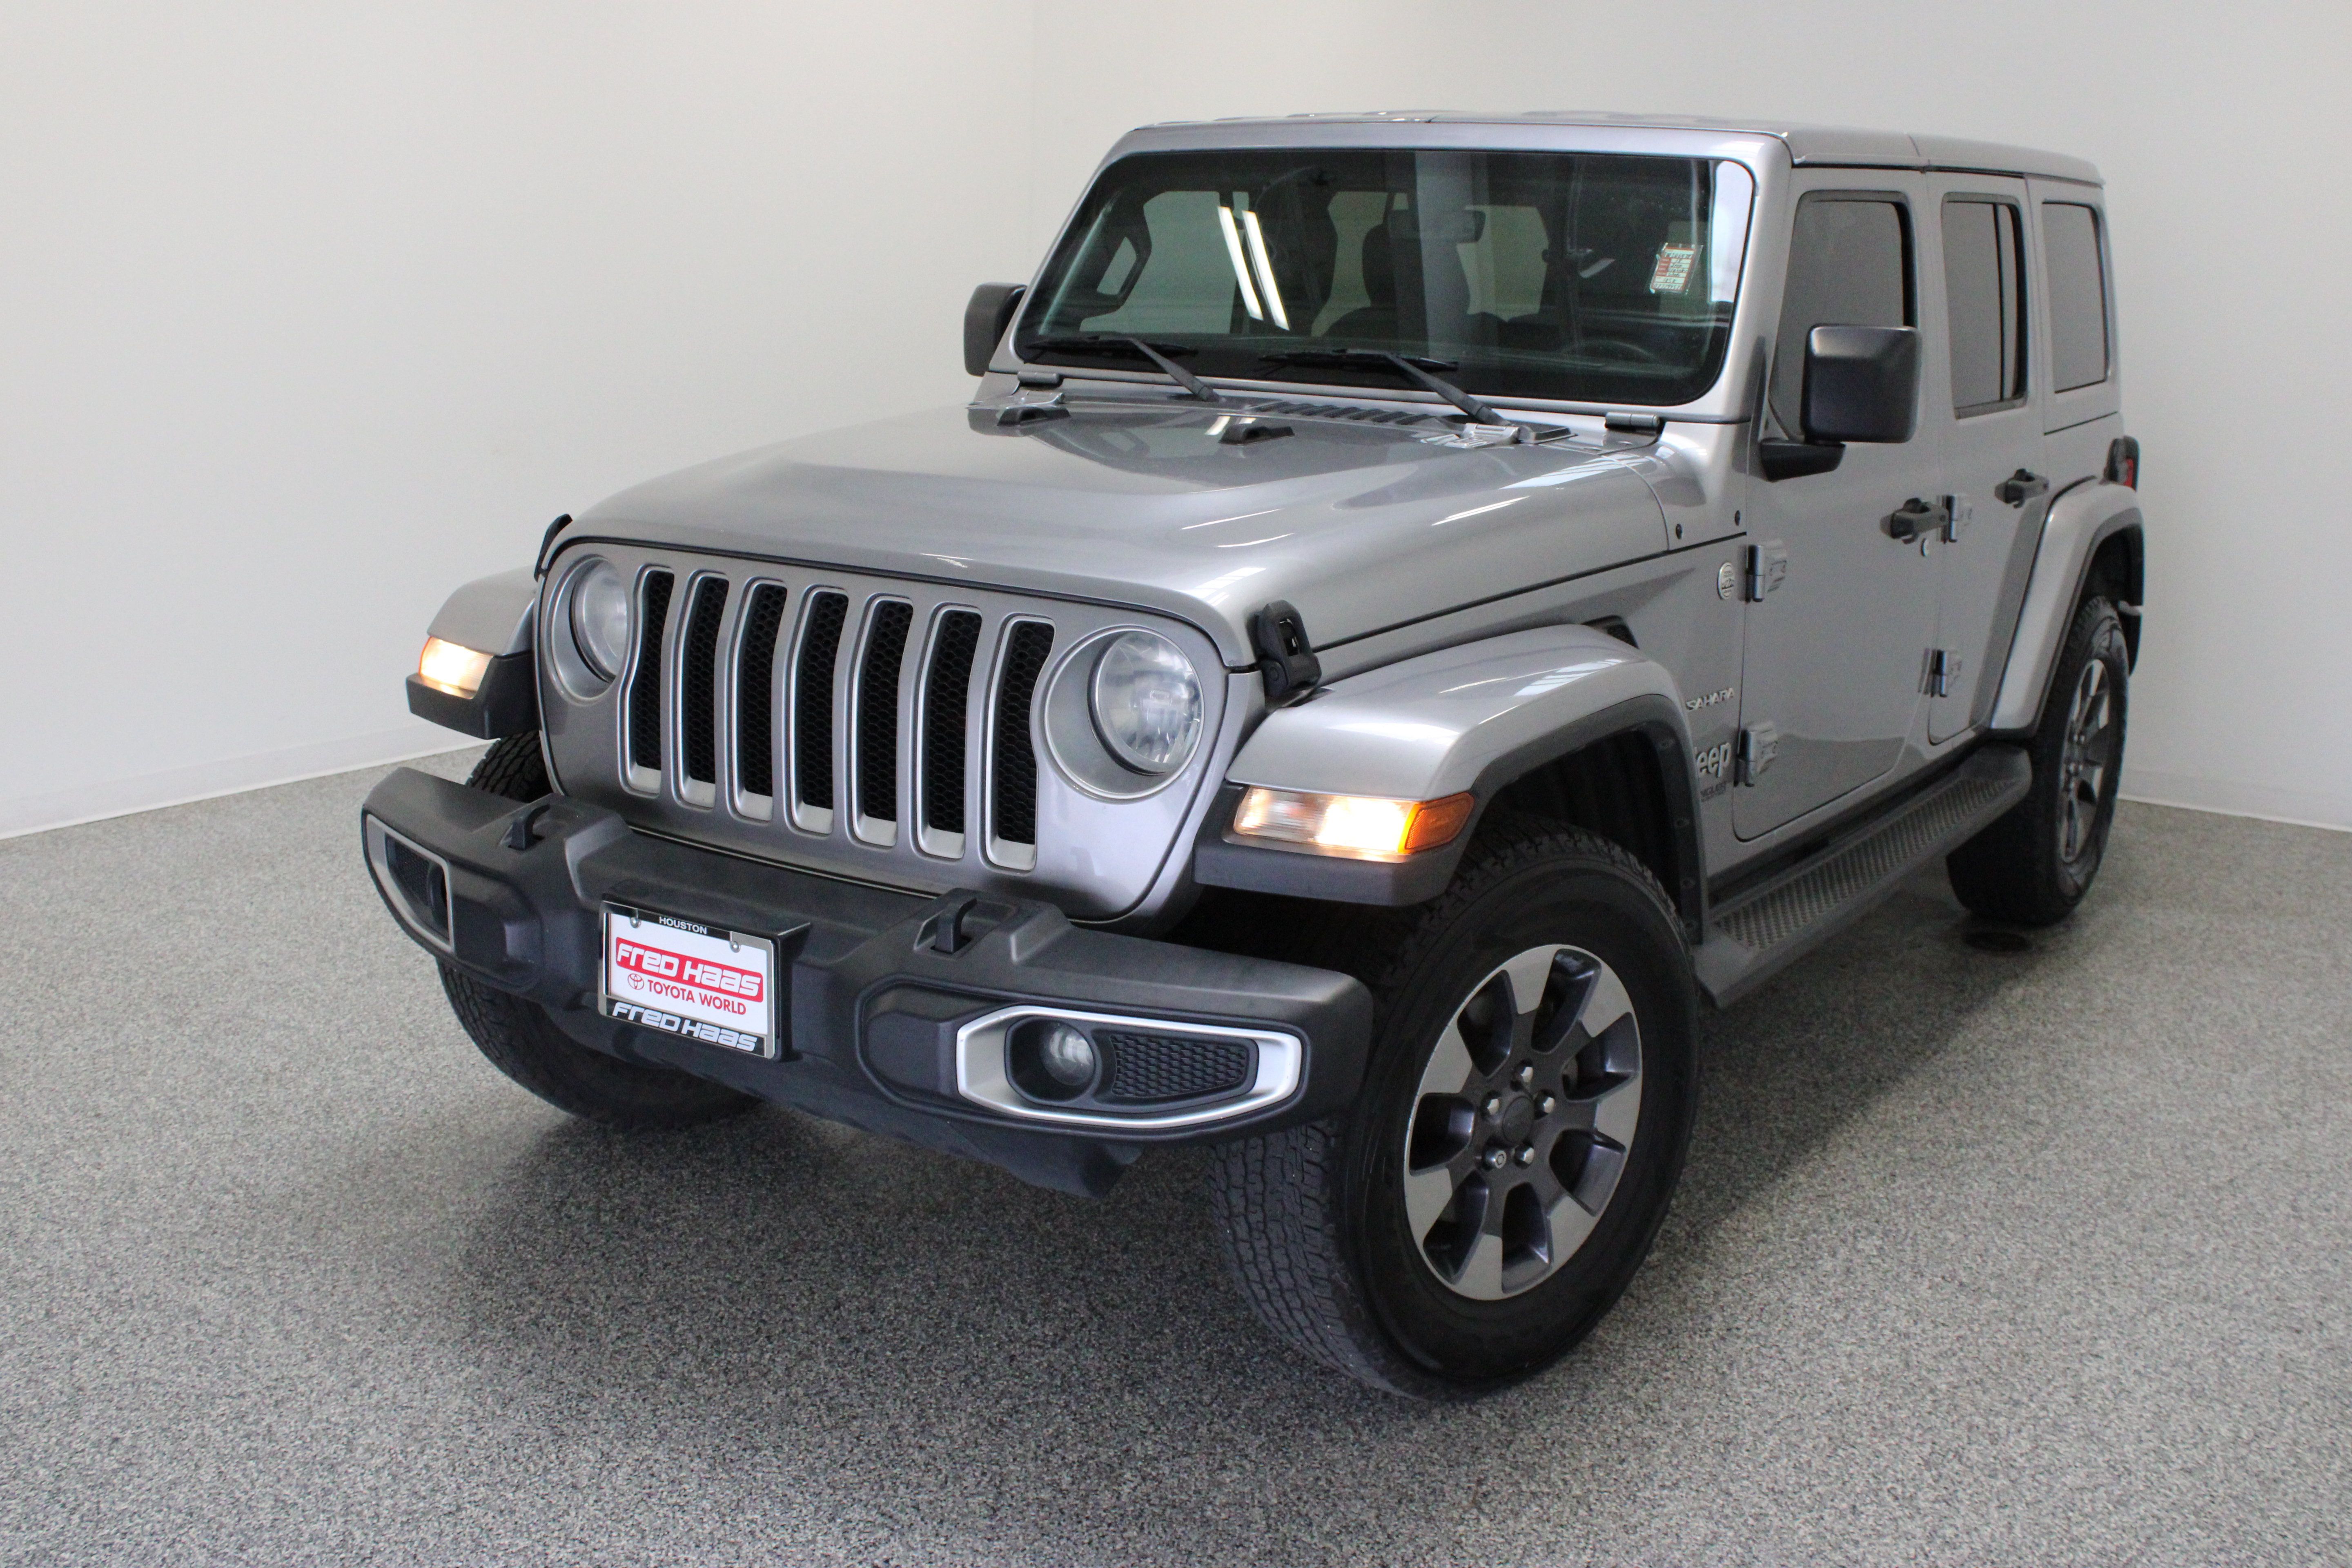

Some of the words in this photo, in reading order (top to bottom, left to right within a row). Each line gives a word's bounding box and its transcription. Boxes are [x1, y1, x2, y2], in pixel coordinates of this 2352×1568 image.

[1686, 688, 1734, 710] SAHARA
[659, 916, 707, 934] HOUSTON
[647, 980, 695, 1003] TOYOTA
[699, 993, 746, 1015] WORLD
